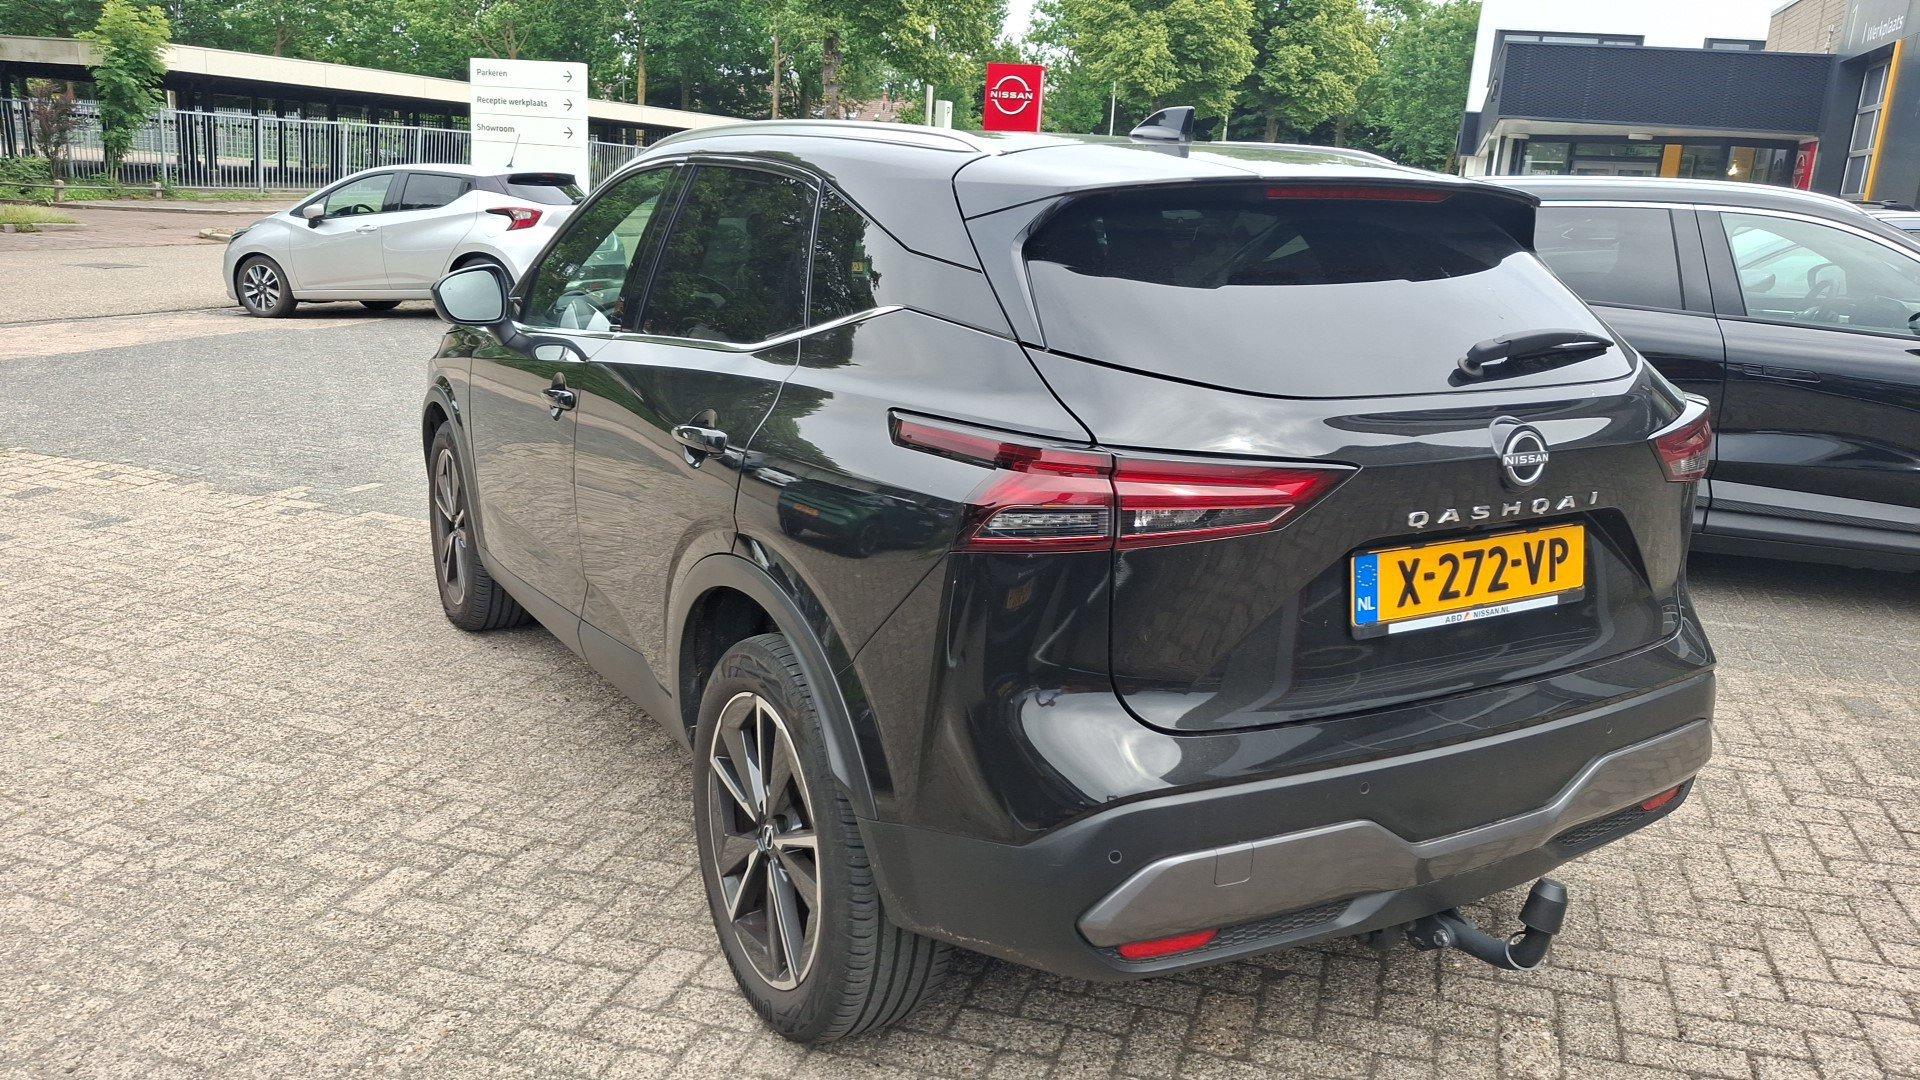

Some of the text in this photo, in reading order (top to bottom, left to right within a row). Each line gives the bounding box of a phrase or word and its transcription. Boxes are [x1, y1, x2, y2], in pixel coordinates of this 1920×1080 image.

[476, 68, 508, 77] Parkeren
[990, 90, 1034, 100] NISSAN
[476, 96, 548, 108] Receptie werkplaats
[476, 124, 515, 133] Showroom
[1504, 453, 1549, 466] NISSAN
[1407, 491, 1599, 528] QASHQAI
[1396, 537, 1570, 608] X-272-VP
[1357, 596, 1376, 612] NL
[1444, 606, 1511, 624] ABD NISSAN.NL
